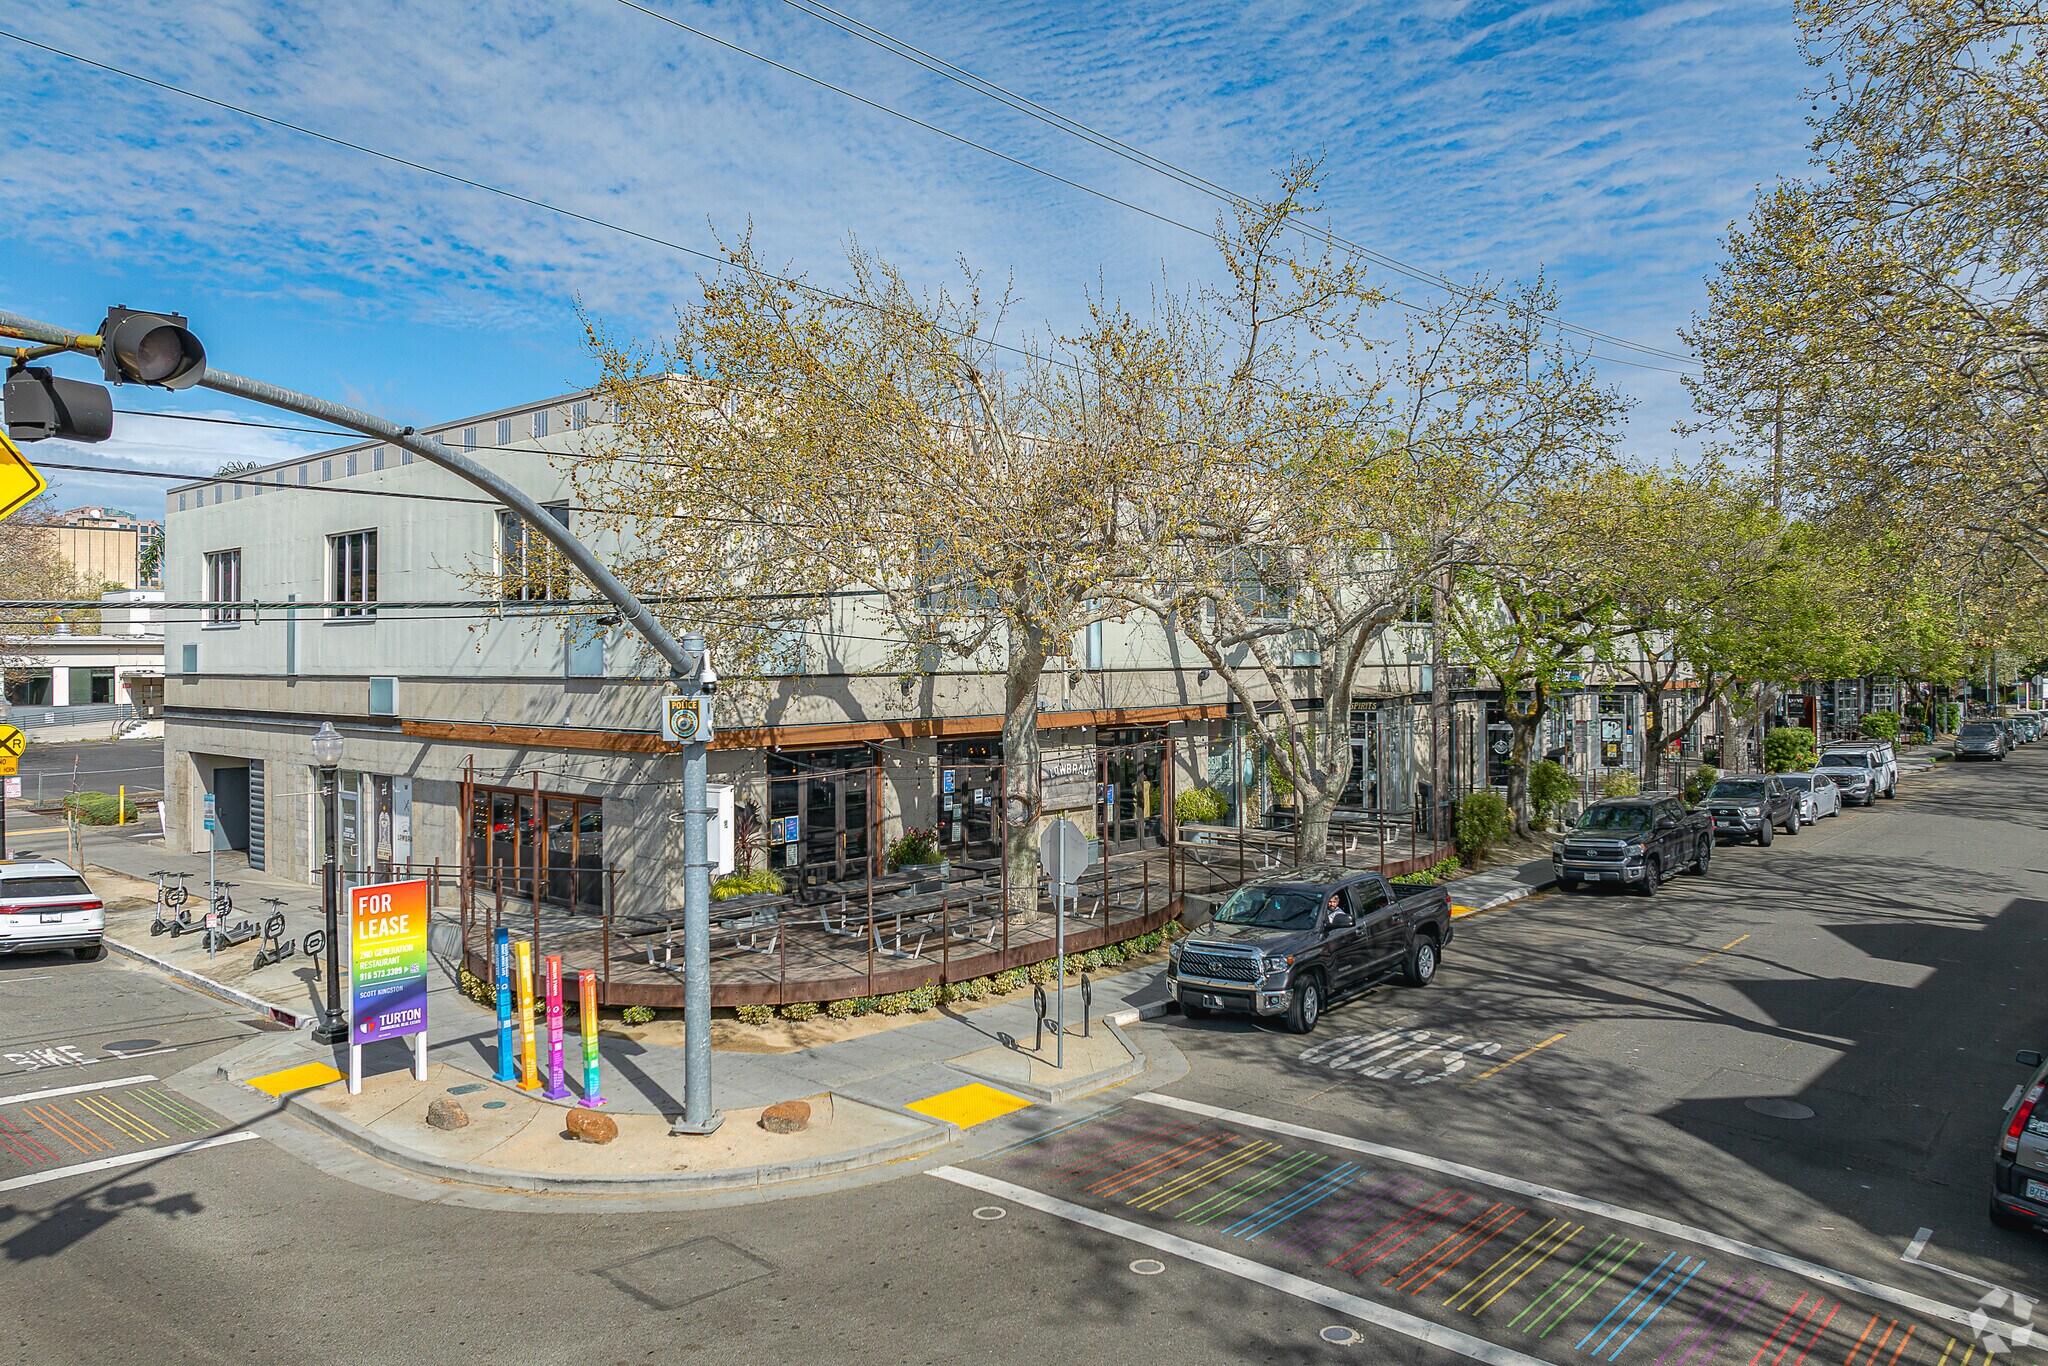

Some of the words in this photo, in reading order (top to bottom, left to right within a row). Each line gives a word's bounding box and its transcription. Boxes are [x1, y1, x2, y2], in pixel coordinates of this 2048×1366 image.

[671, 701, 697, 709] POLICE
[1350, 702, 1377, 710] SPIRITS
[12, 739, 21, 748] R
[358, 893, 392, 916] FOR
[359, 914, 410, 940] LEASE
[360, 949, 372, 960] 2ND
[374, 943, 414, 957] GENERATION
[360, 956, 400, 970] RESTAURANT
[360, 971, 372, 981] 916
[359, 990, 377, 999] SCOTT
[377, 985, 404, 995] KINGSTON
[379, 1007, 422, 1026] TURTON
[2, 1045, 101, 1072] BIKE
